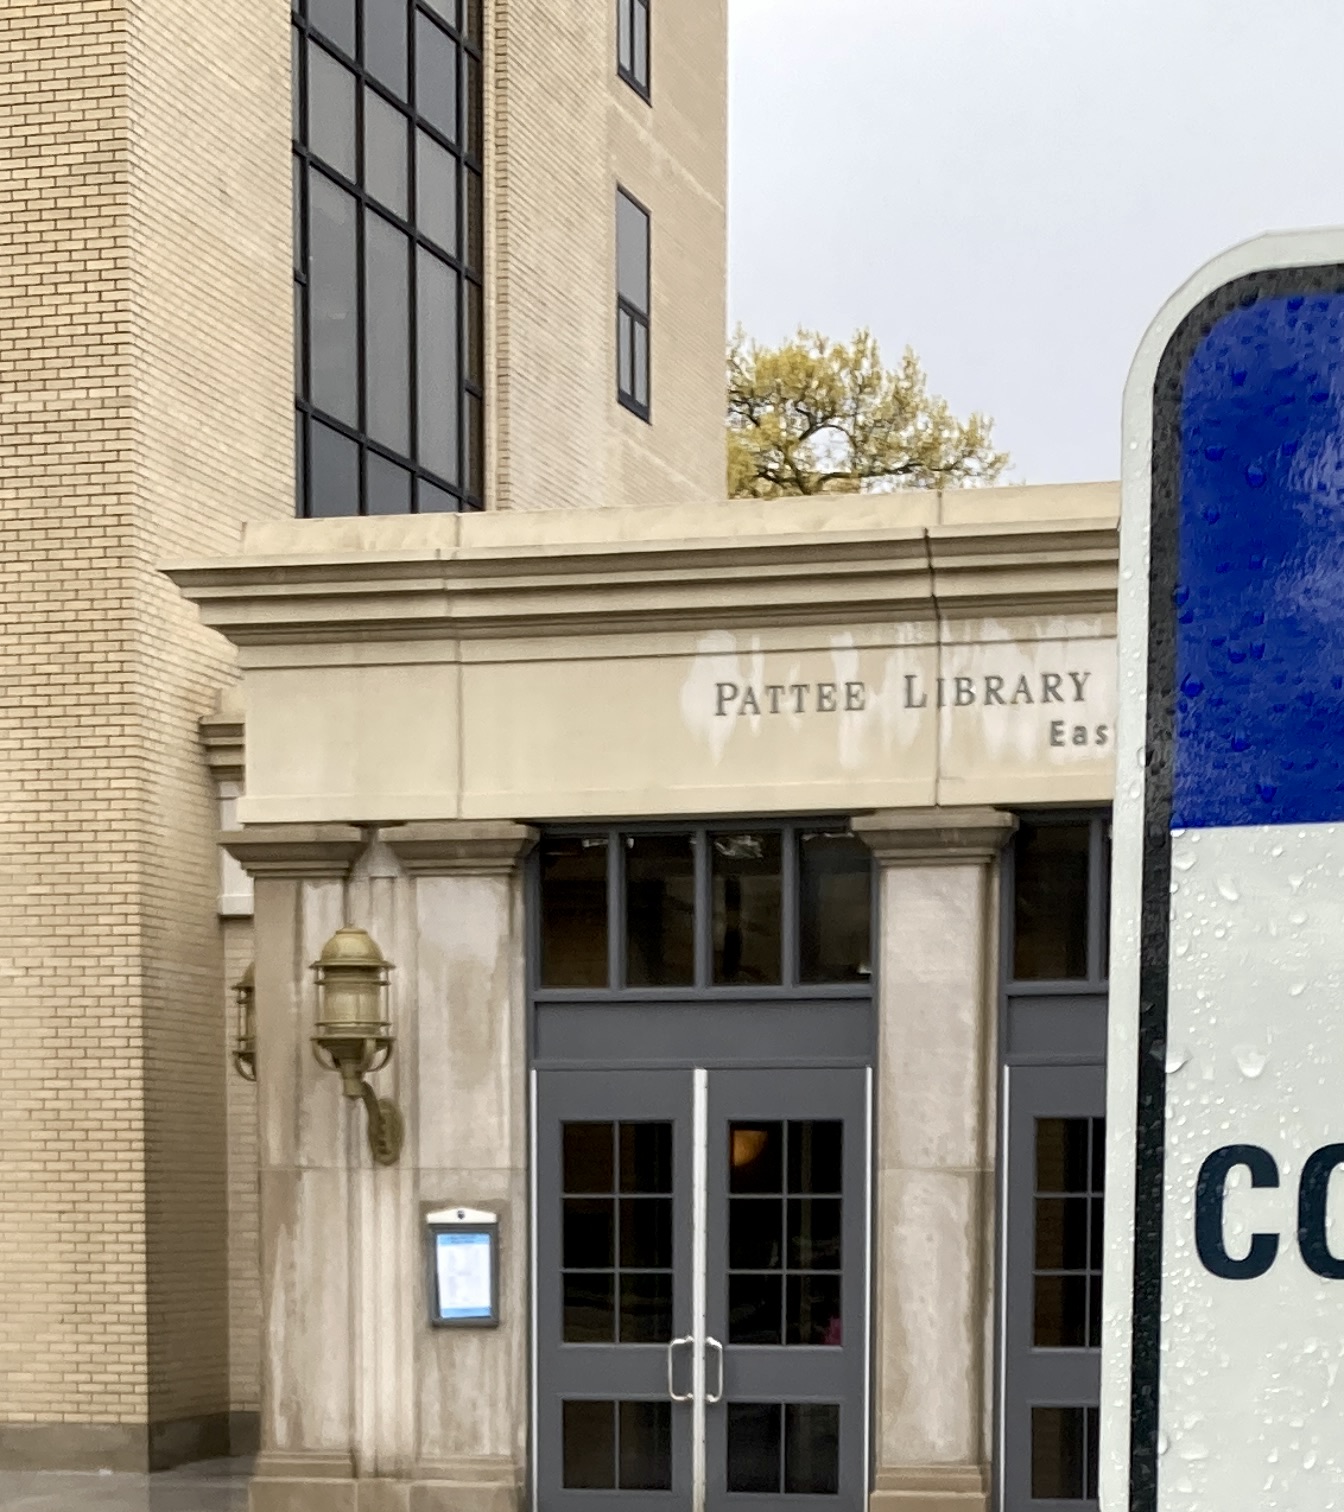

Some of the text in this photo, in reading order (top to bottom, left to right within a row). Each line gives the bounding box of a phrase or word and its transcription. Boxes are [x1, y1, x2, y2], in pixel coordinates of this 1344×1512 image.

[714, 671, 1092, 717] PATTEE LIBRARY
[1049, 719, 1109, 748] Eas
